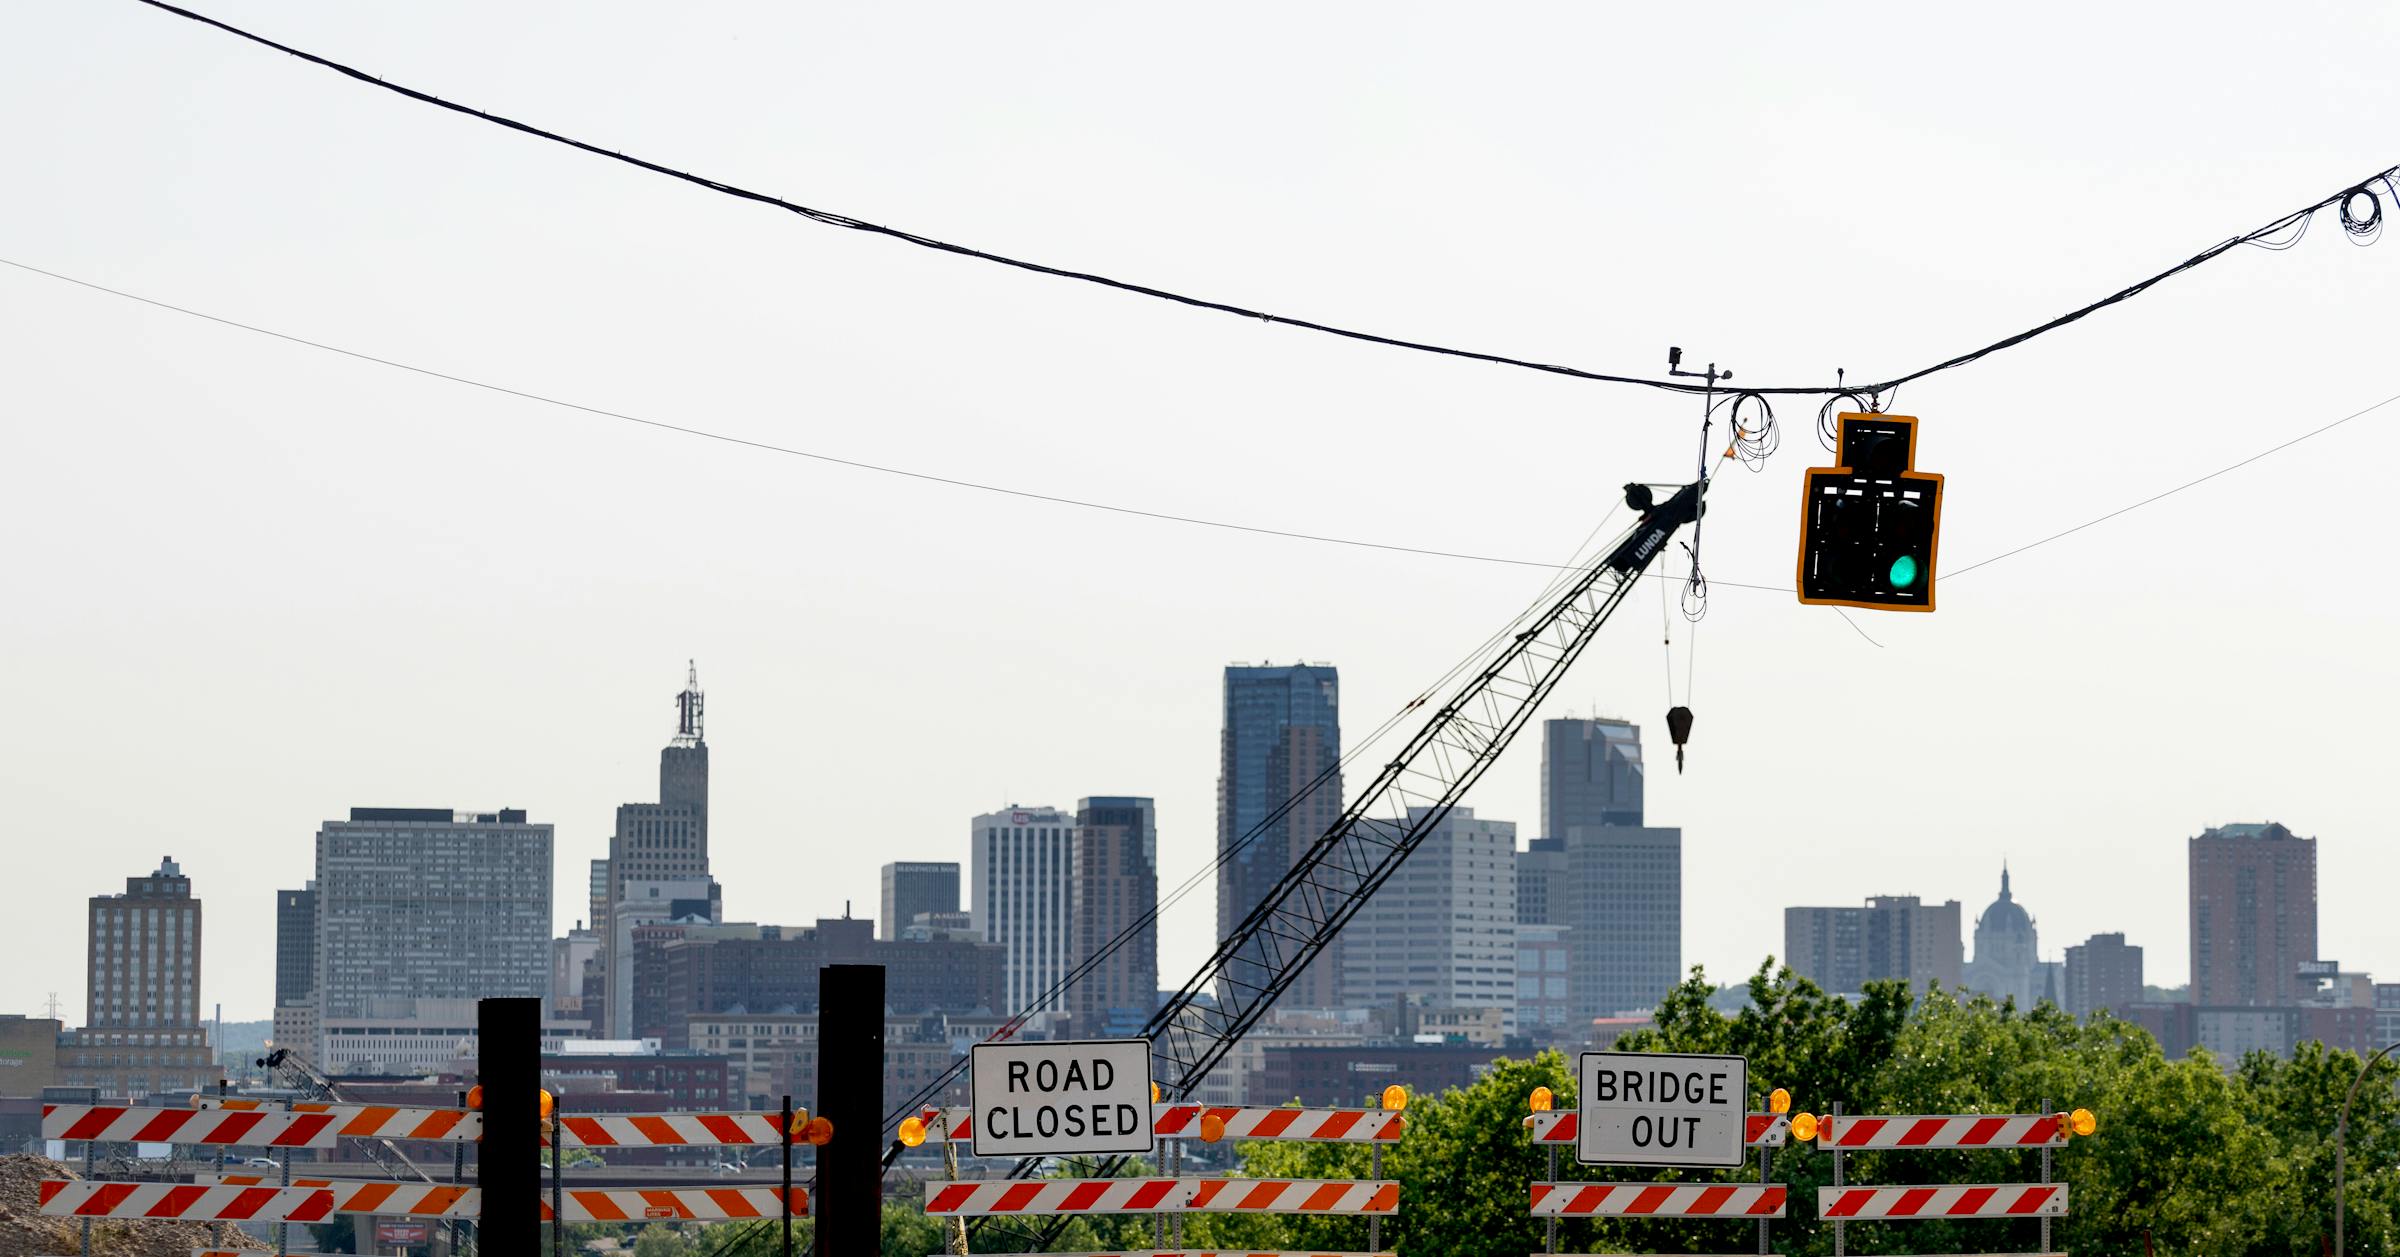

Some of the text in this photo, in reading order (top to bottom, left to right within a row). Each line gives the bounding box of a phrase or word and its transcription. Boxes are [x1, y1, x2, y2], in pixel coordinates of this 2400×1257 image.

[1635, 529, 1665, 560] LUNDA
[1008, 1059, 1114, 1093] ROAD
[1597, 1070, 1727, 1104] BRIDGE
[987, 1104, 1138, 1139] CLOSED
[1632, 1115, 1701, 1148] OUT
